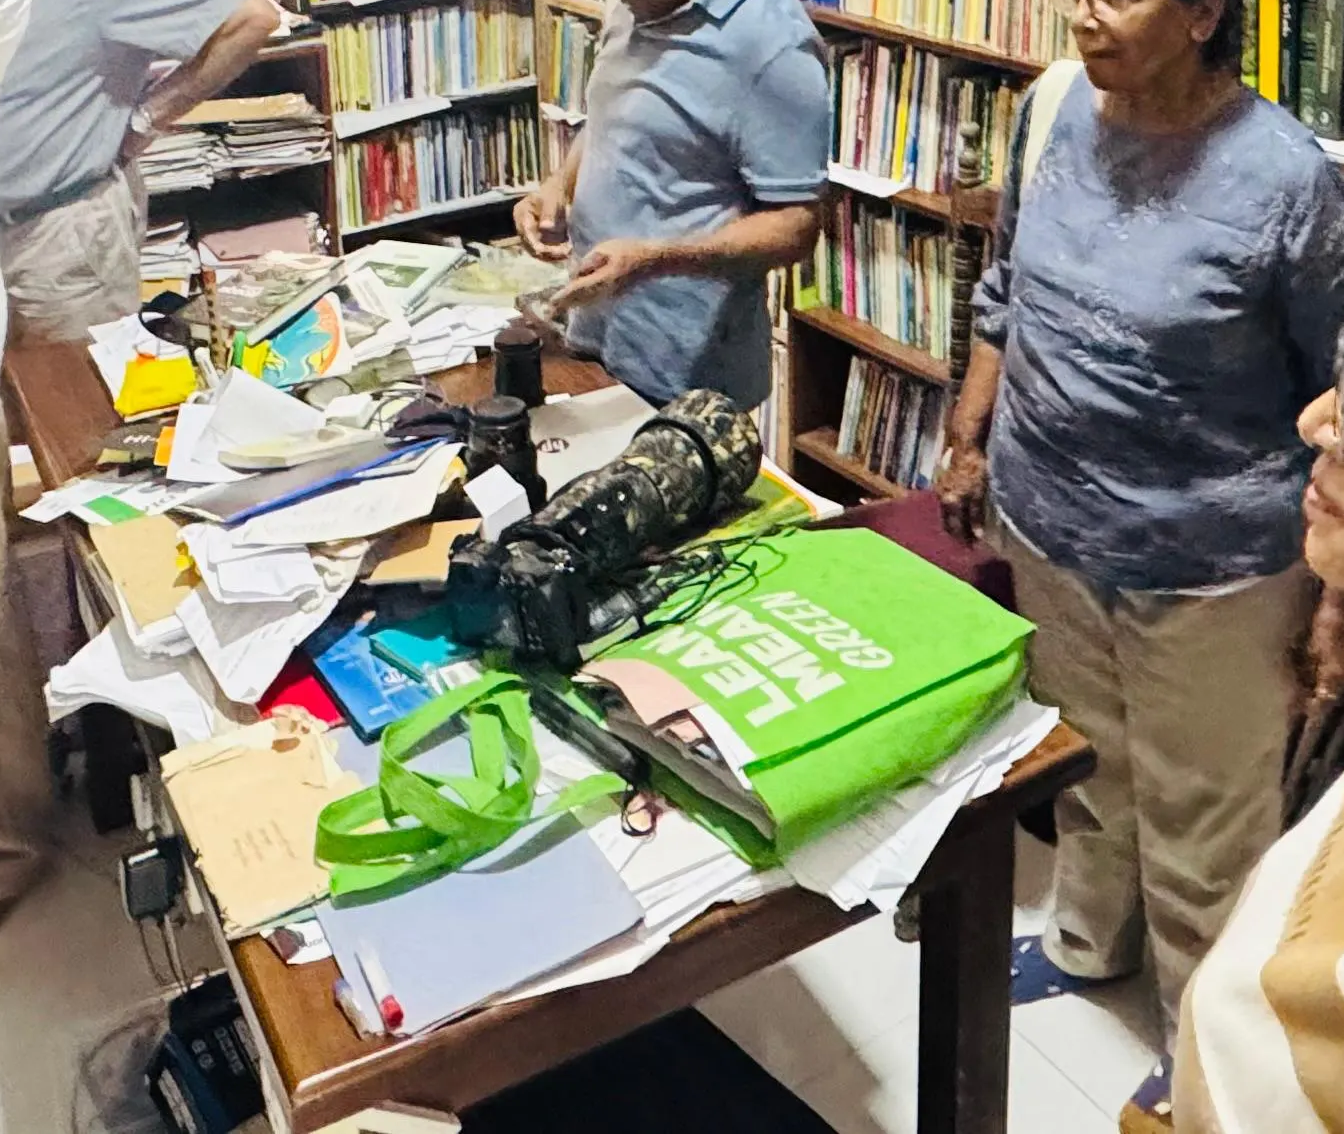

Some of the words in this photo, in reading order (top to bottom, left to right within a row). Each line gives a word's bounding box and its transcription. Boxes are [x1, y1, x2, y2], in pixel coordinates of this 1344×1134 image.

[643, 627, 800, 730] LEAN
[695, 600, 846, 703] MEAN
[759, 590, 895, 670] GREEN
